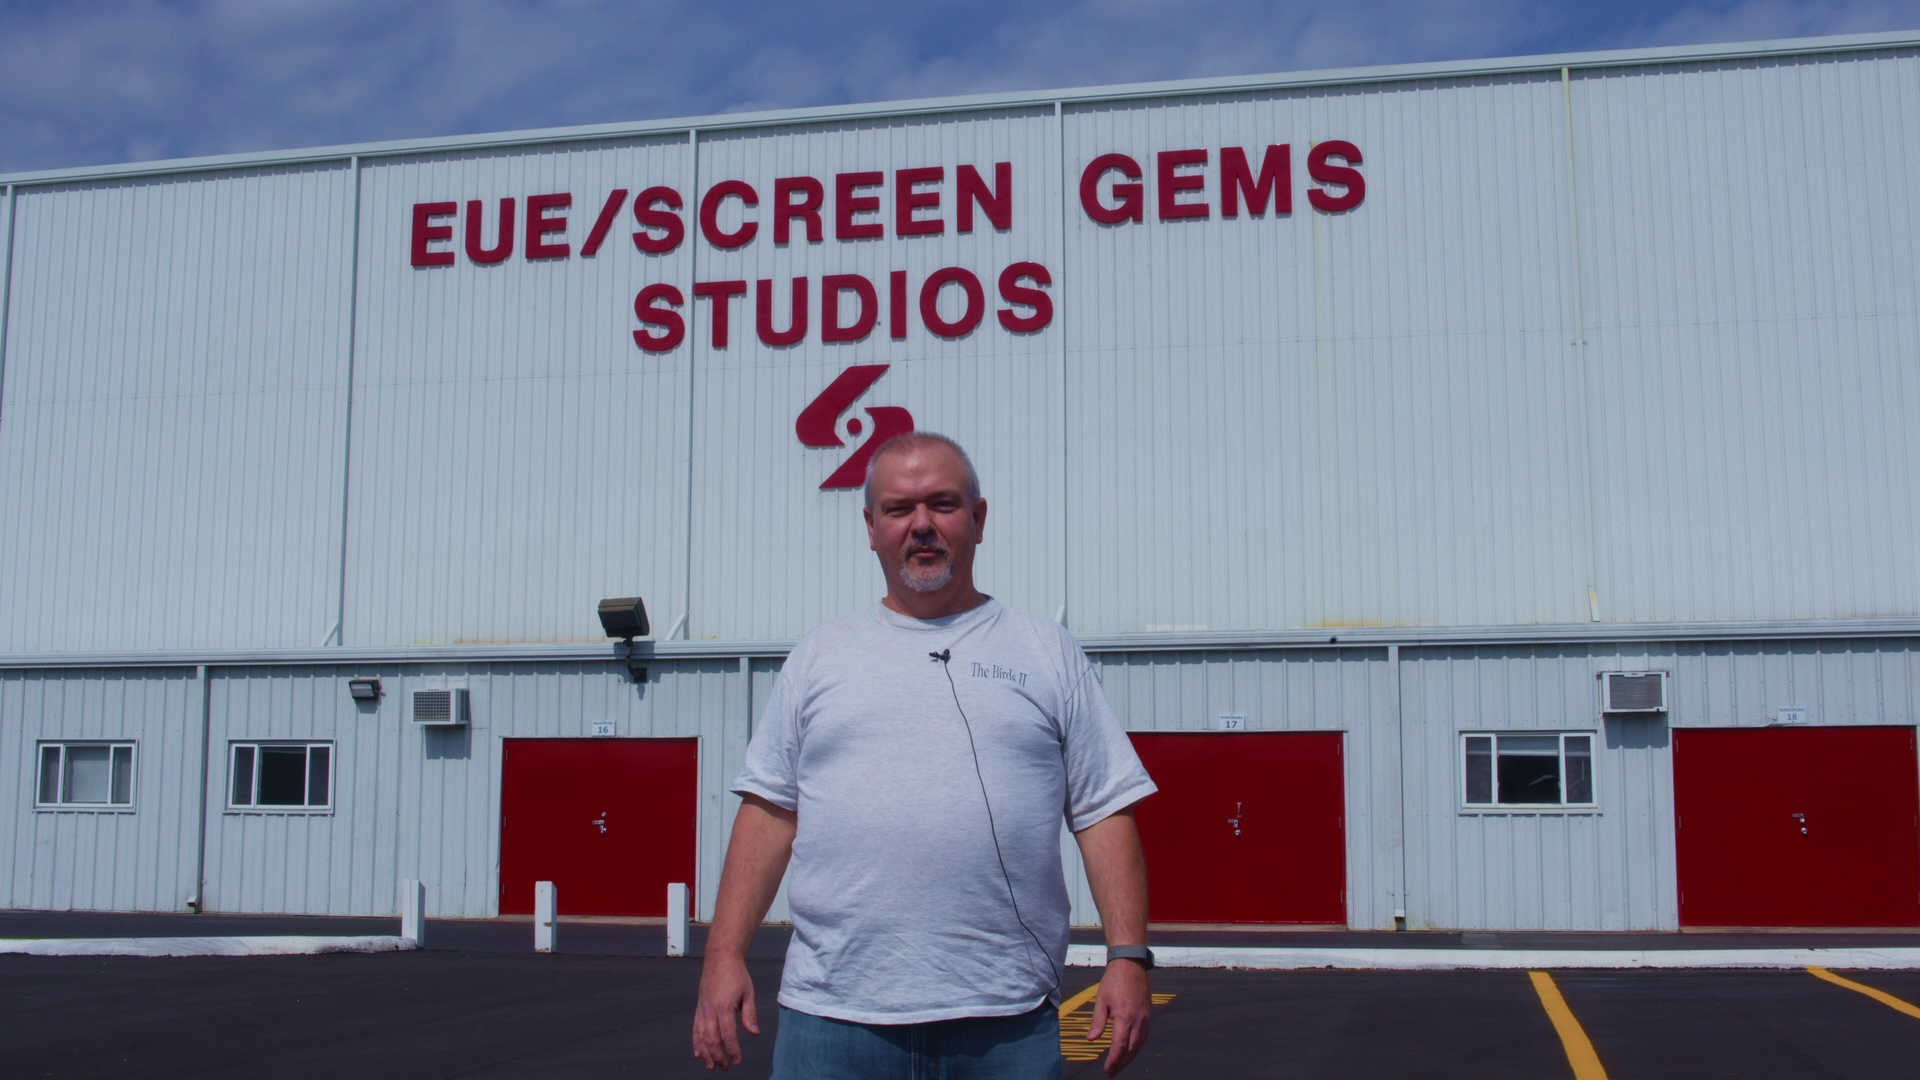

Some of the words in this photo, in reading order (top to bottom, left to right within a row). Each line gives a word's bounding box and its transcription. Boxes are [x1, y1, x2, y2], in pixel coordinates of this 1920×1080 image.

[410, 161, 1013, 267] EUE/SCREEN
[1079, 140, 1366, 224] GEMS
[632, 261, 1054, 352] STUDIOS
[971, 662, 990, 678] The
[992, 664, 1017, 682] Birds
[1787, 713, 1798, 721] 18
[598, 726, 609, 734] 16
[1225, 720, 1238, 729] 17
